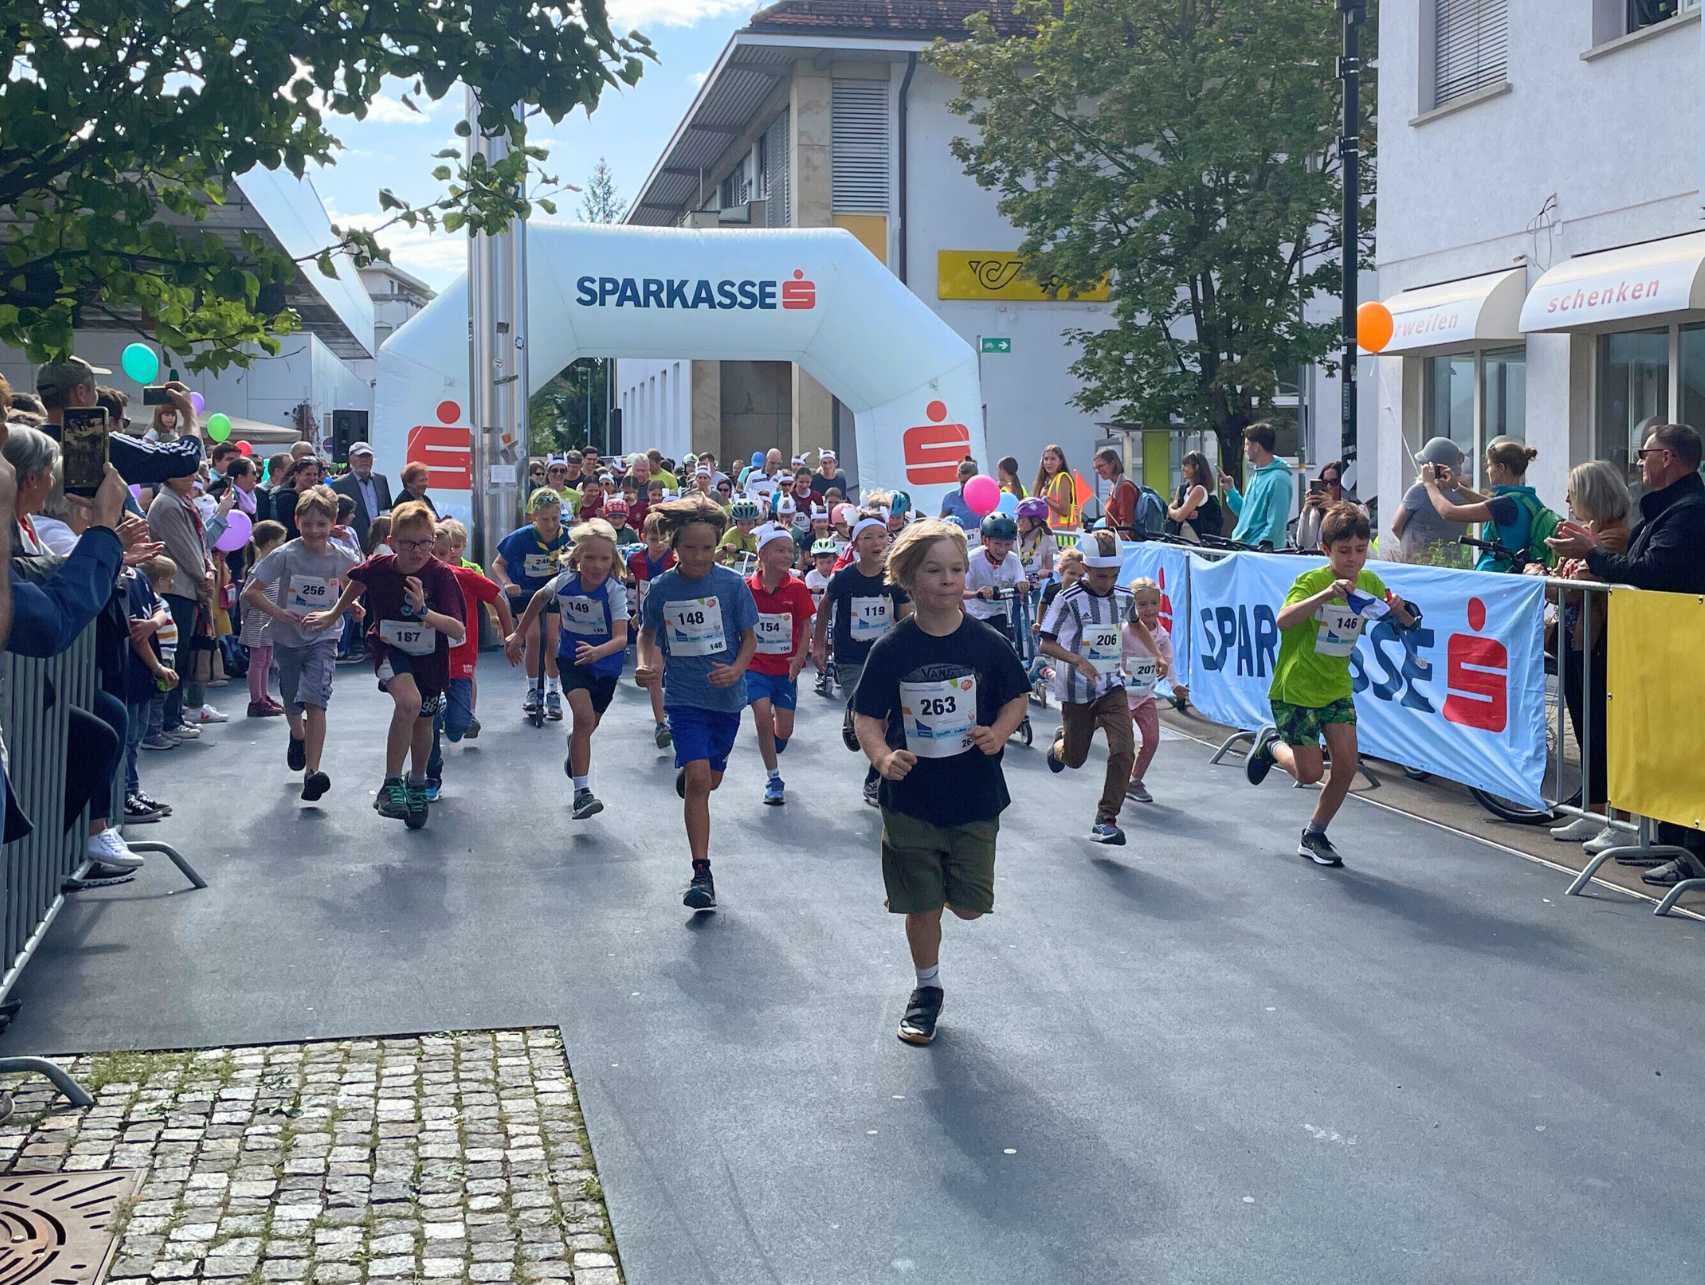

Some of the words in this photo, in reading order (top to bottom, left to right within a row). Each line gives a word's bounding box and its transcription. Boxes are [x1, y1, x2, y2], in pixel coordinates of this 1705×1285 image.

[576, 276, 777, 310] SPARKASSE
[1547, 280, 1660, 313] schenken
[1394, 311, 1458, 338] rweilen
[302, 585, 325, 596] 256
[568, 601, 589, 613] 149
[864, 606, 885, 616] 119
[678, 611, 704, 625] 148
[1337, 616, 1358, 629] 146
[760, 622, 780, 632] 154
[1096, 634, 1117, 646] 206
[920, 696, 957, 716] 263
